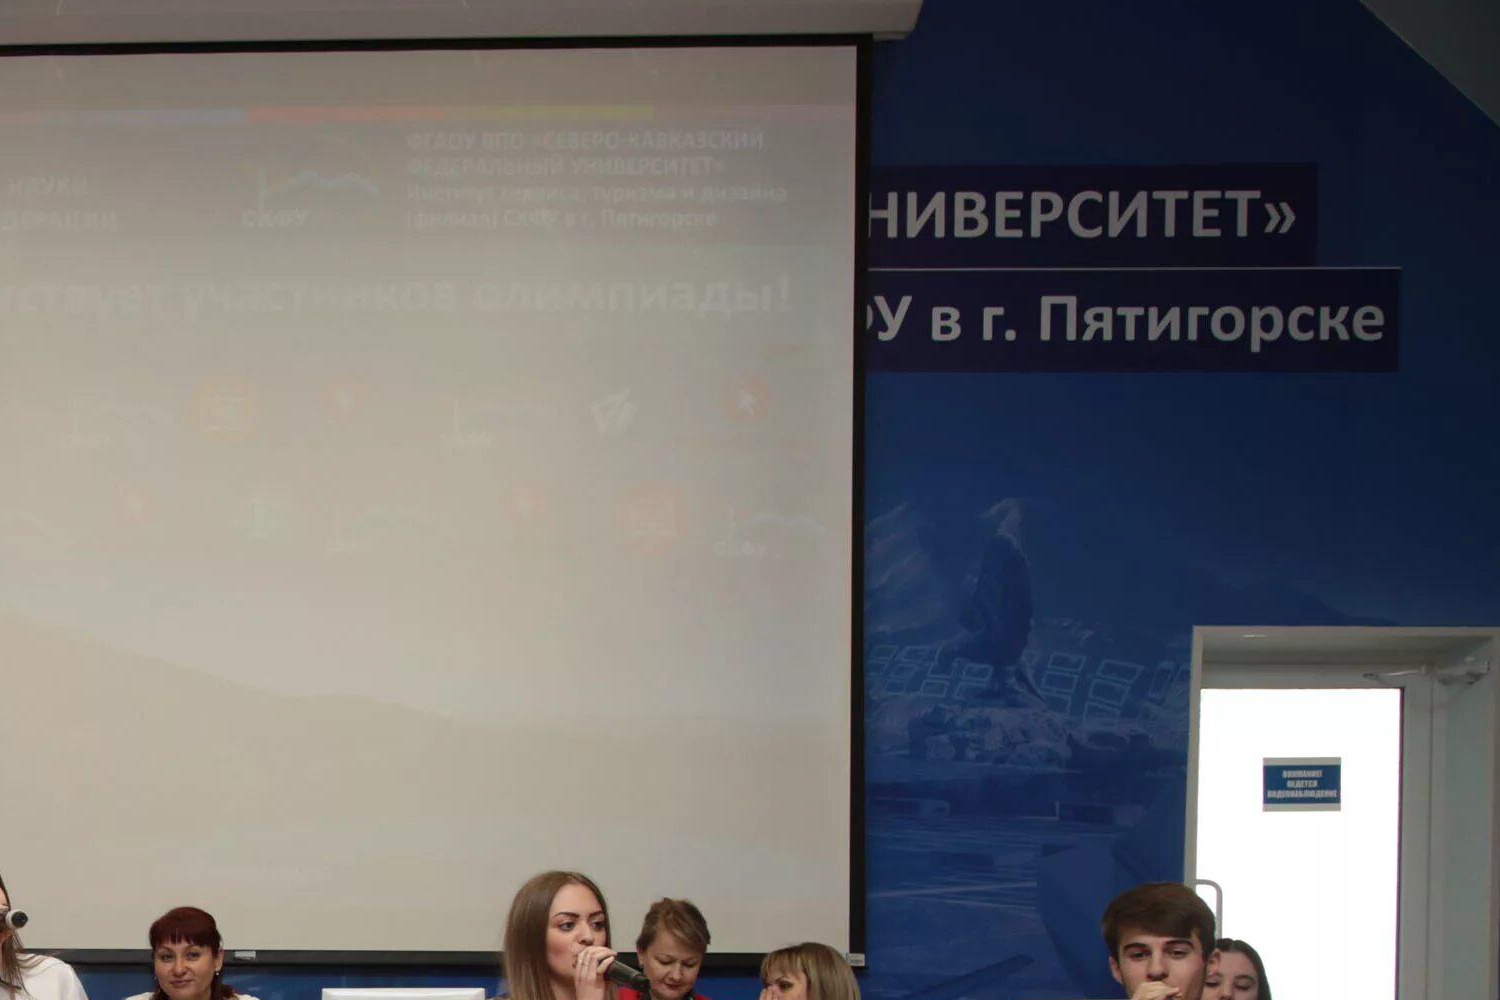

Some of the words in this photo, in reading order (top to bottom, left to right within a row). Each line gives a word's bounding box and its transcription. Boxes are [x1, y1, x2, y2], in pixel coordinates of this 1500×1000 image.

[869, 190, 1296, 239] НИВЕРСИТЕТ»
[931, 306, 962, 341] в
[983, 306, 1017, 341] г.
[1040, 295, 1385, 352] Пятигорске
